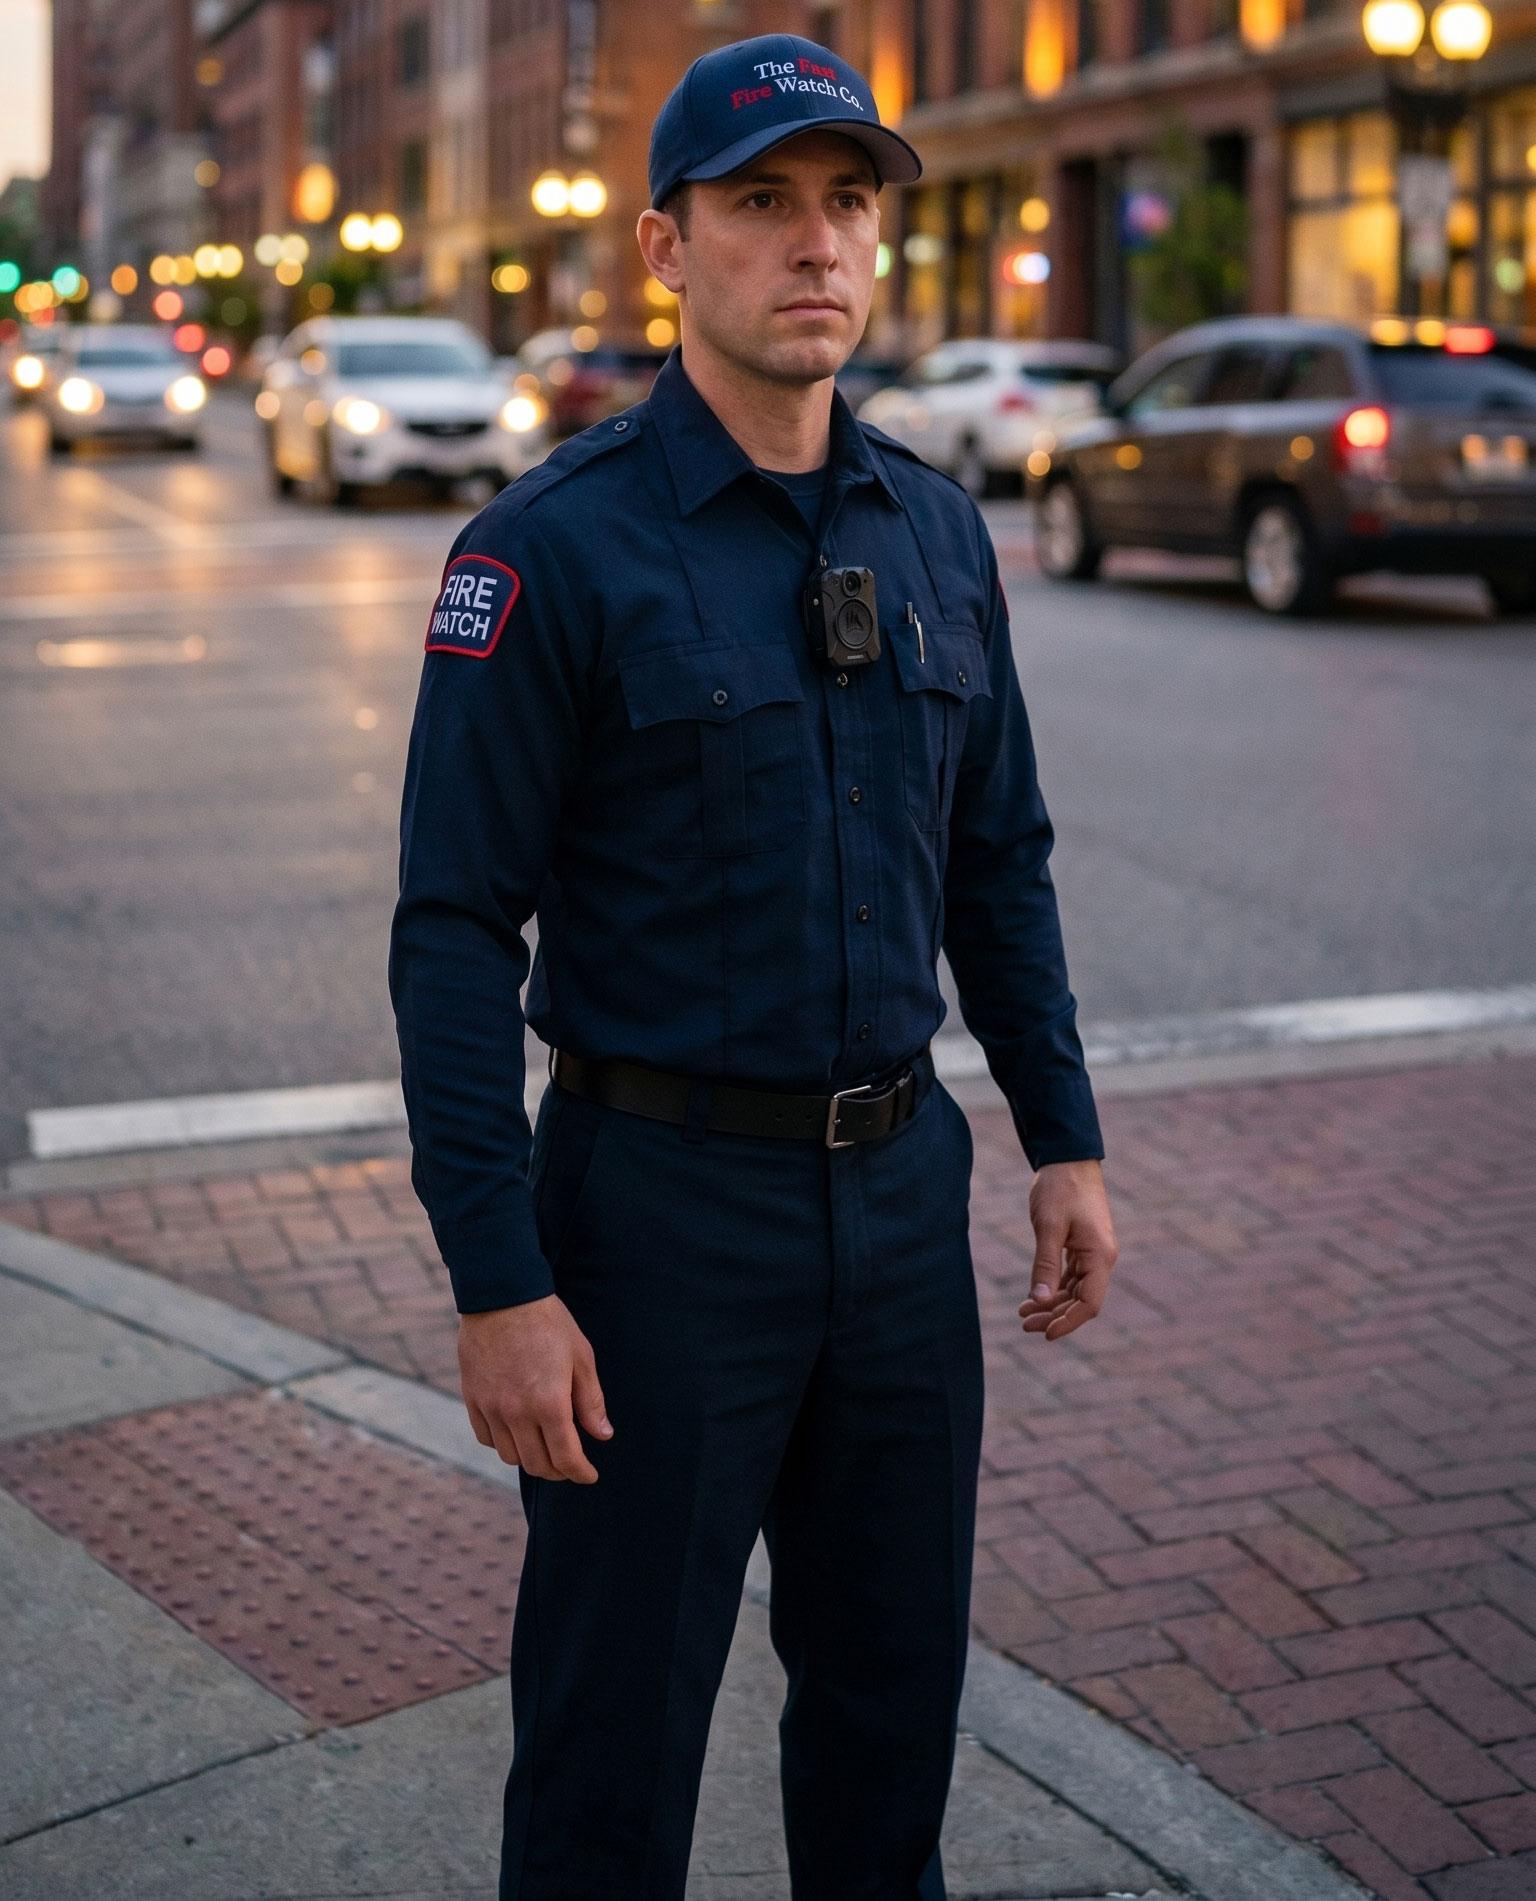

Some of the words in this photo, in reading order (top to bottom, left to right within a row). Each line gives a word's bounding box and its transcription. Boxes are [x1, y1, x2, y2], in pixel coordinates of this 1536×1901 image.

[753, 61, 795, 80] The
[730, 86, 773, 109] Fire
[774, 77, 838, 98] Watch
[839, 86, 864, 112] Co.
[440, 574, 497, 610] FIRE
[431, 611, 491, 640] WATCH
